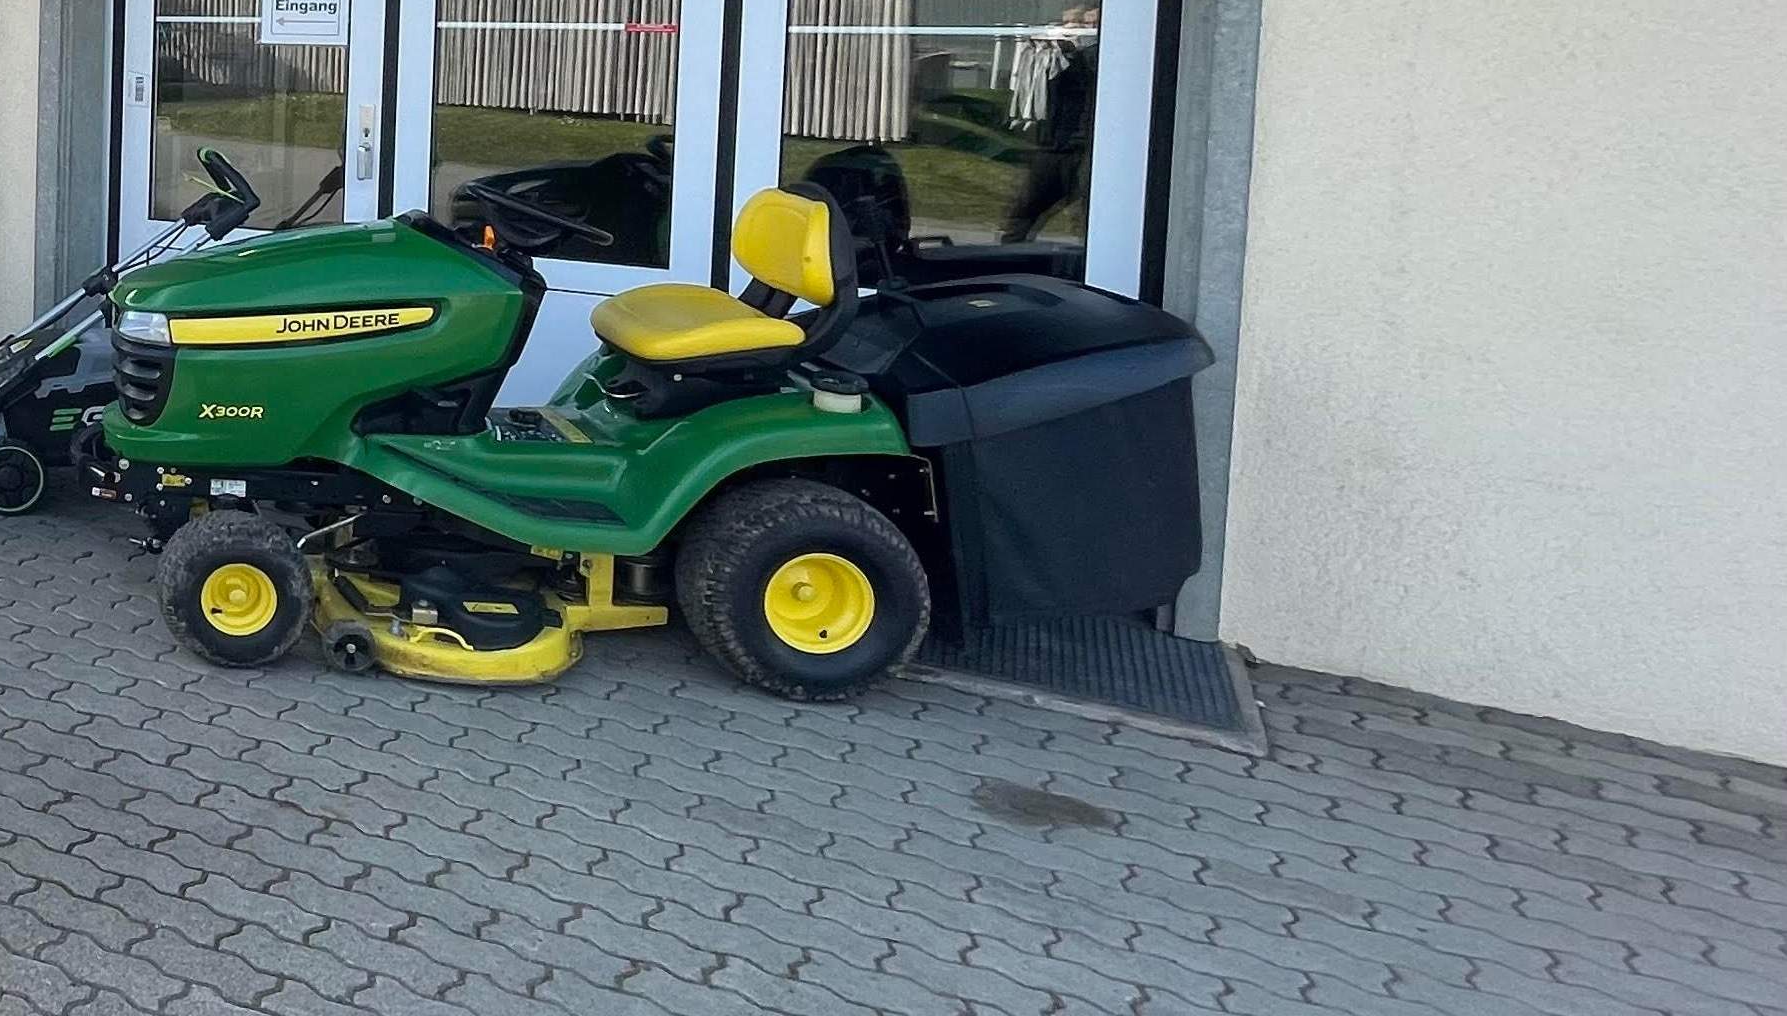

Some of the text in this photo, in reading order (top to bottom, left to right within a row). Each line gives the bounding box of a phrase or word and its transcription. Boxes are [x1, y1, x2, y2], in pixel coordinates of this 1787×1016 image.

[275, 0, 337, 14] Eingang
[276, 313, 400, 334] JOHN DEERE
[50, 406, 105, 431] EG
[198, 404, 264, 419] X300R
